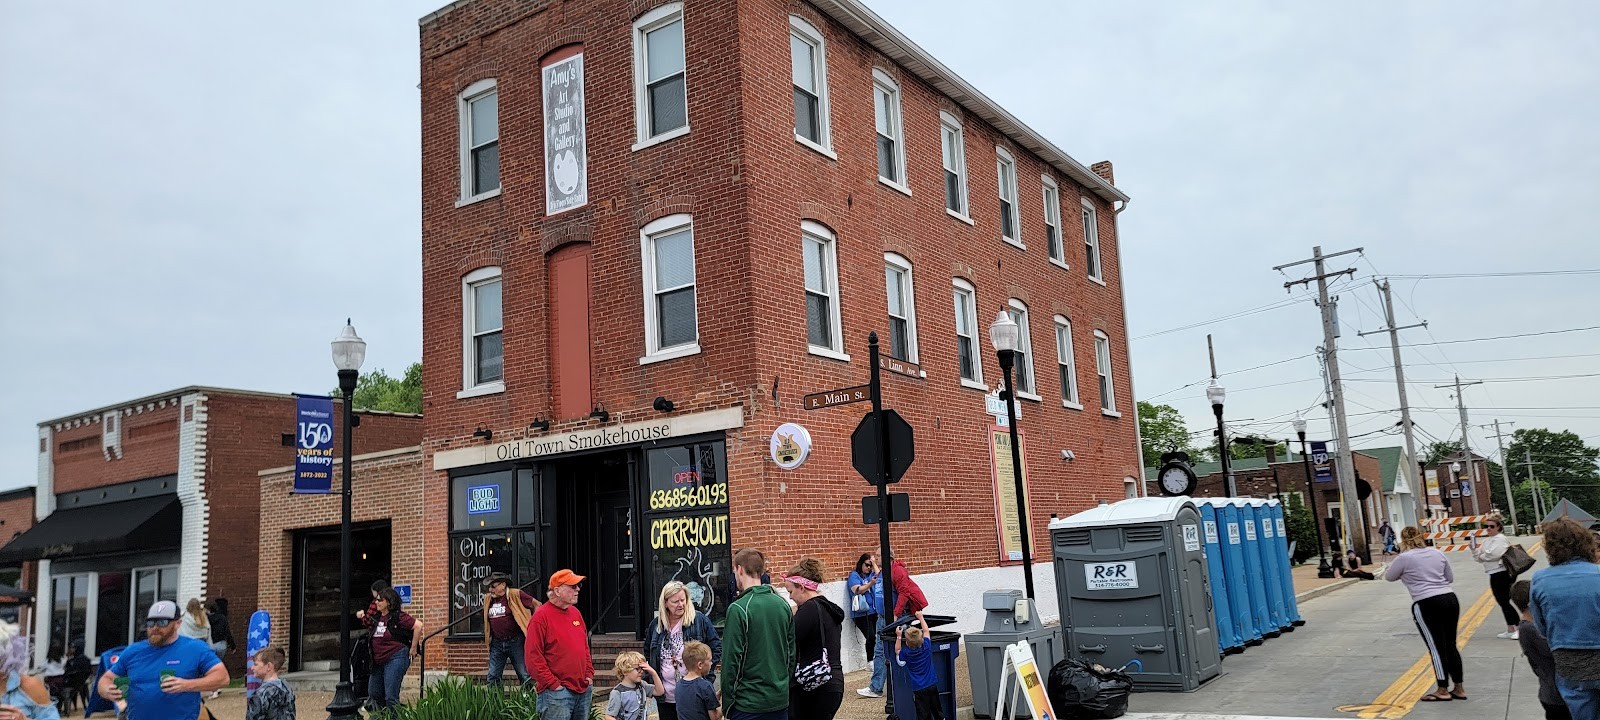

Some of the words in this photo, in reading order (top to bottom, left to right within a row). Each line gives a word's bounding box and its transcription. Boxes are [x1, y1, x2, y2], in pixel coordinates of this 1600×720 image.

[550, 64, 575, 88] Amy's
[559, 90, 568, 104] Art
[554, 104, 573, 121] Studio
[558, 118, 570, 135] and
[554, 134, 576, 151] Gallery
[889, 359, 904, 373] Linn
[812, 399, 820, 407] E.
[825, 392, 850, 405] Main
[854, 391, 865, 399] St.
[299, 422, 332, 449] 150
[496, 443, 521, 461] Old
[525, 440, 564, 457] Town
[568, 424, 670, 450] Smokehouse
[298, 448, 321, 457] years
[323, 448, 333, 456] of
[300, 455, 332, 466] history
[674, 471, 700, 484] OPEN
[473, 488, 494, 500] BUD
[470, 498, 498, 511] LIGHT
[460, 537, 486, 557] Old
[460, 561, 492, 582] Town
[1094, 564, 1127, 579] R&R
